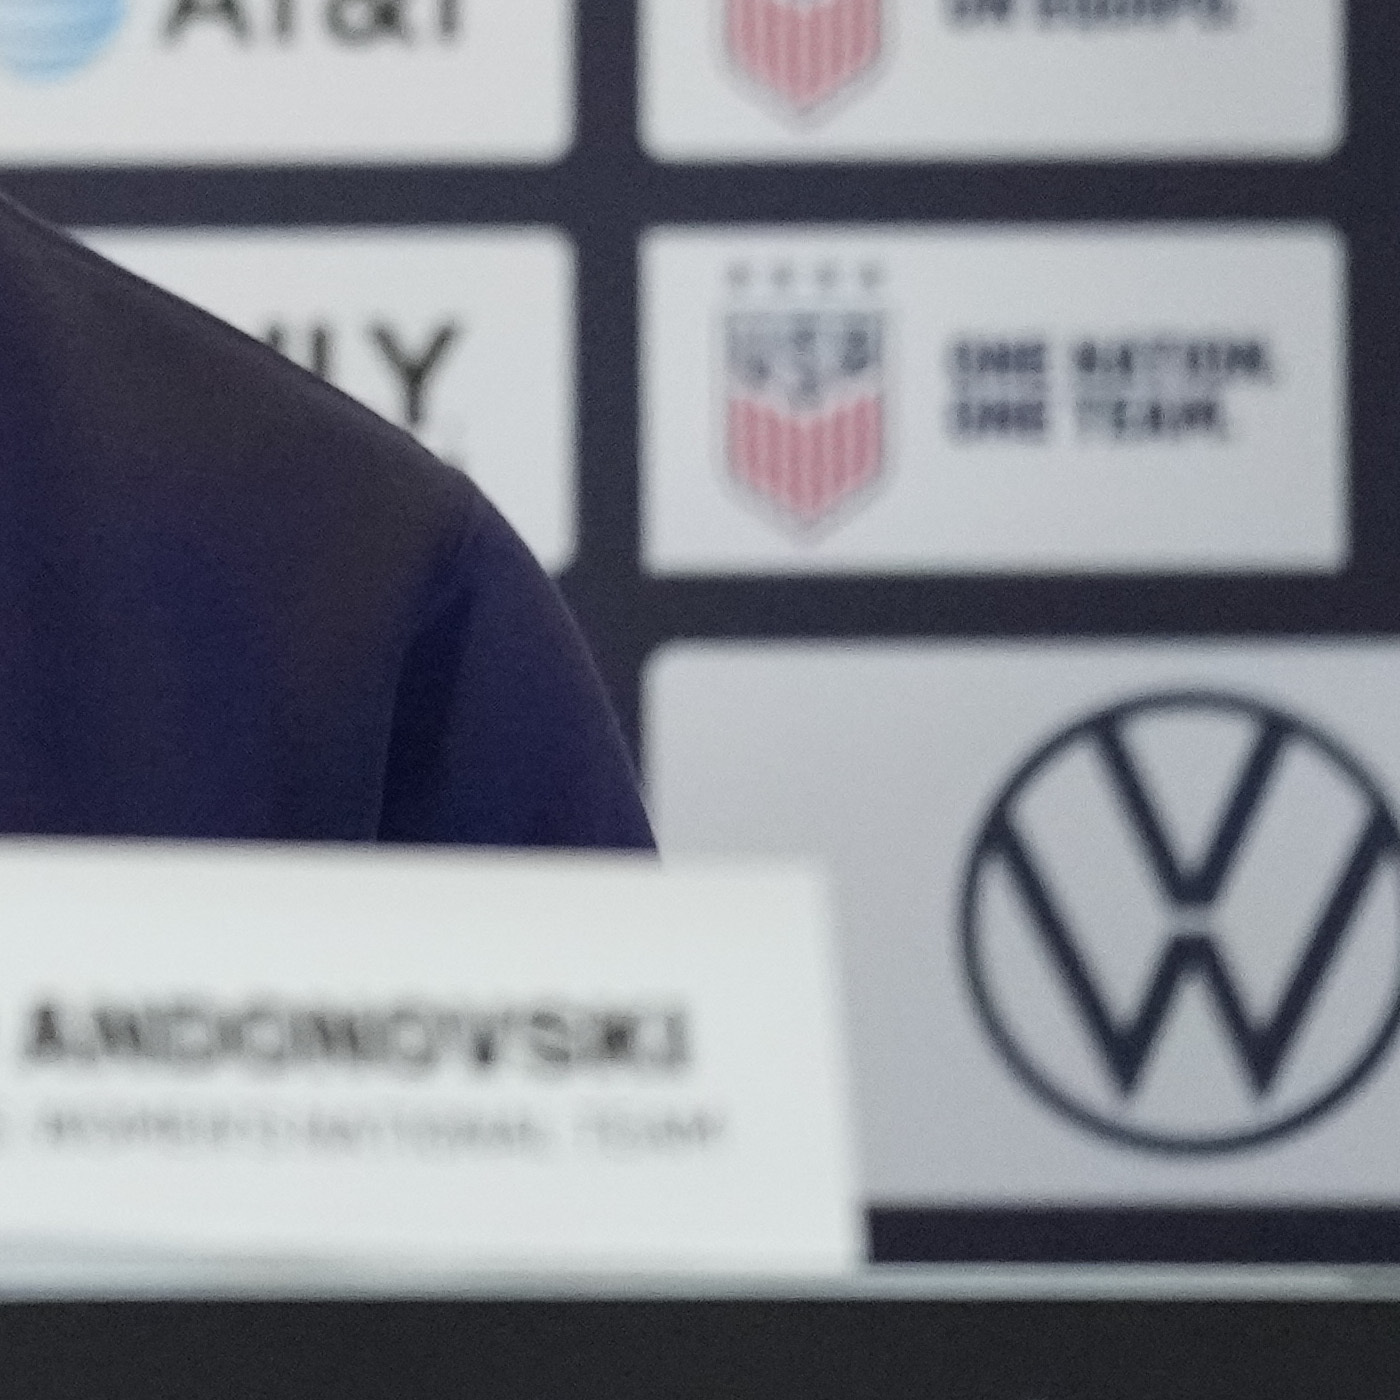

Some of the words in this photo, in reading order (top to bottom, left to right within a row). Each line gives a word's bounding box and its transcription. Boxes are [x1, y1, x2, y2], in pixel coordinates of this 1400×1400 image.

[946, 334, 1052, 385] ONE
[946, 393, 1052, 442] ONE
[18, 994, 695, 1074] ANDONOVSKI
